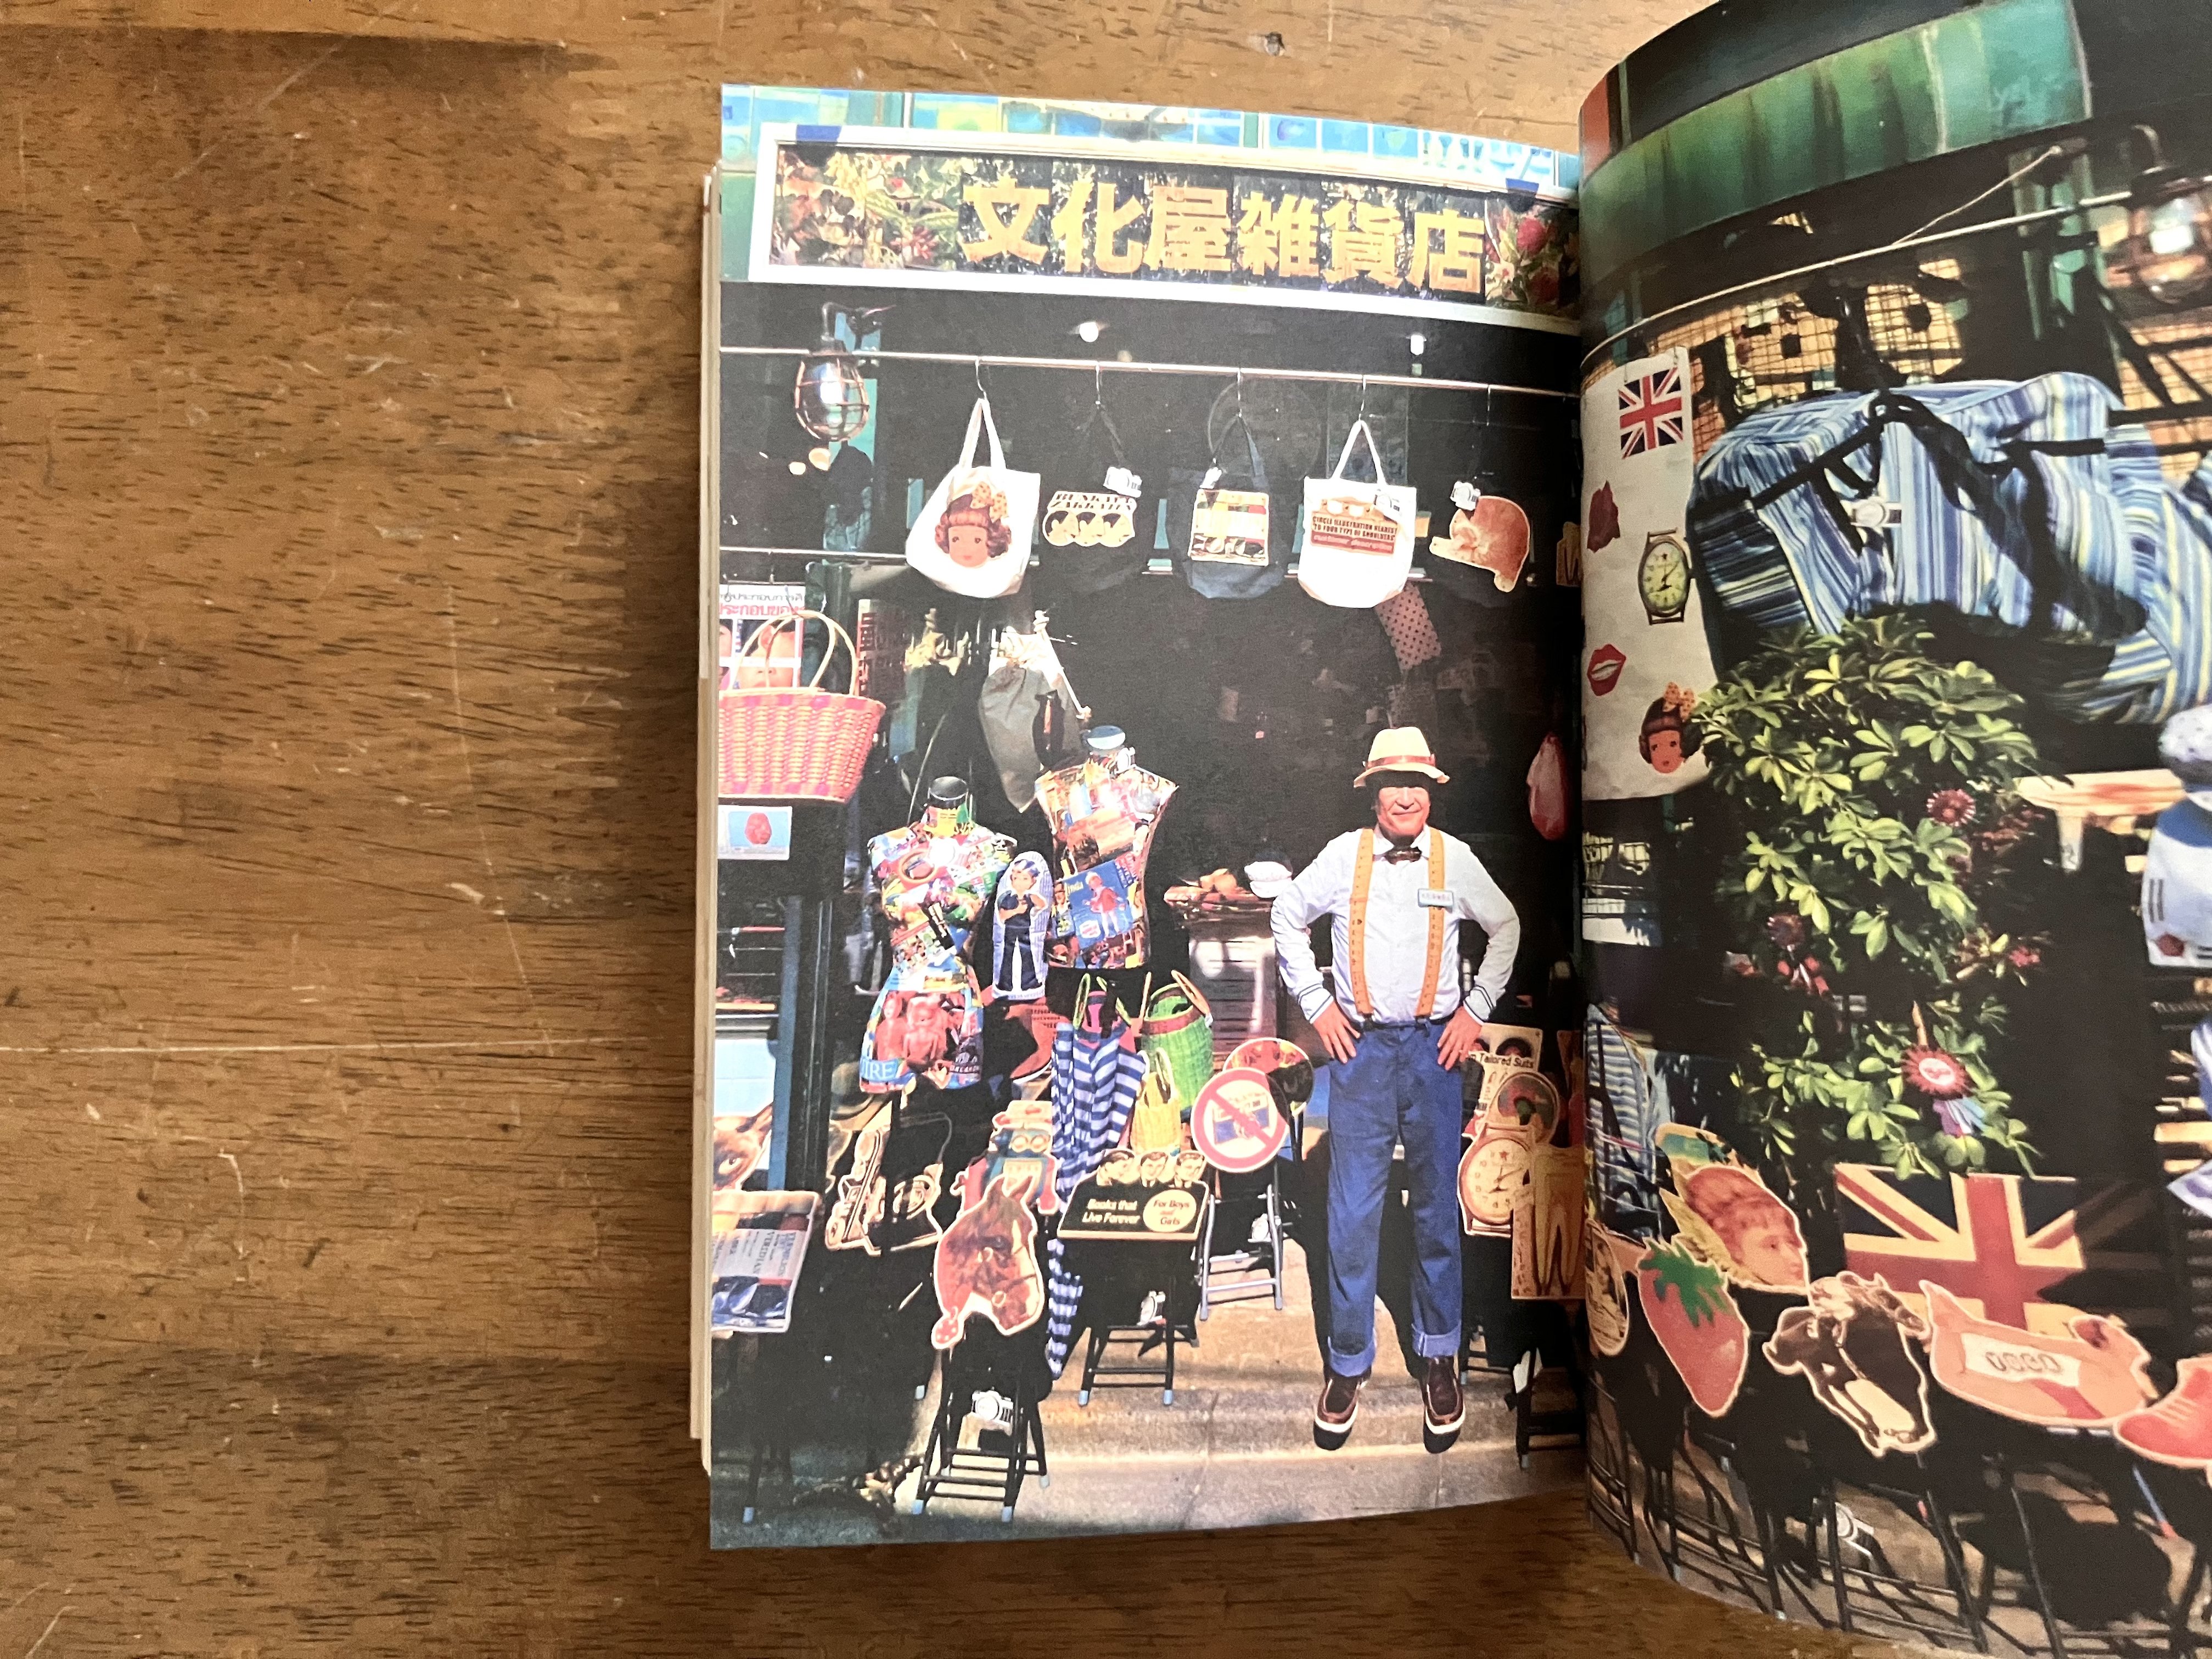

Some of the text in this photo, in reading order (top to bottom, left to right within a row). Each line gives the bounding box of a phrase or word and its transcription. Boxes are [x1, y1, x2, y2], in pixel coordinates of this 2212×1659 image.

[958, 176, 1485, 294] 文化屋雑貨店
[1087, 1198, 1138, 1210] Books that
[1153, 1200, 1190, 1209] For Boys
[1081, 1211, 1141, 1224] Live Forever
[1160, 1216, 1181, 1226] Girls
